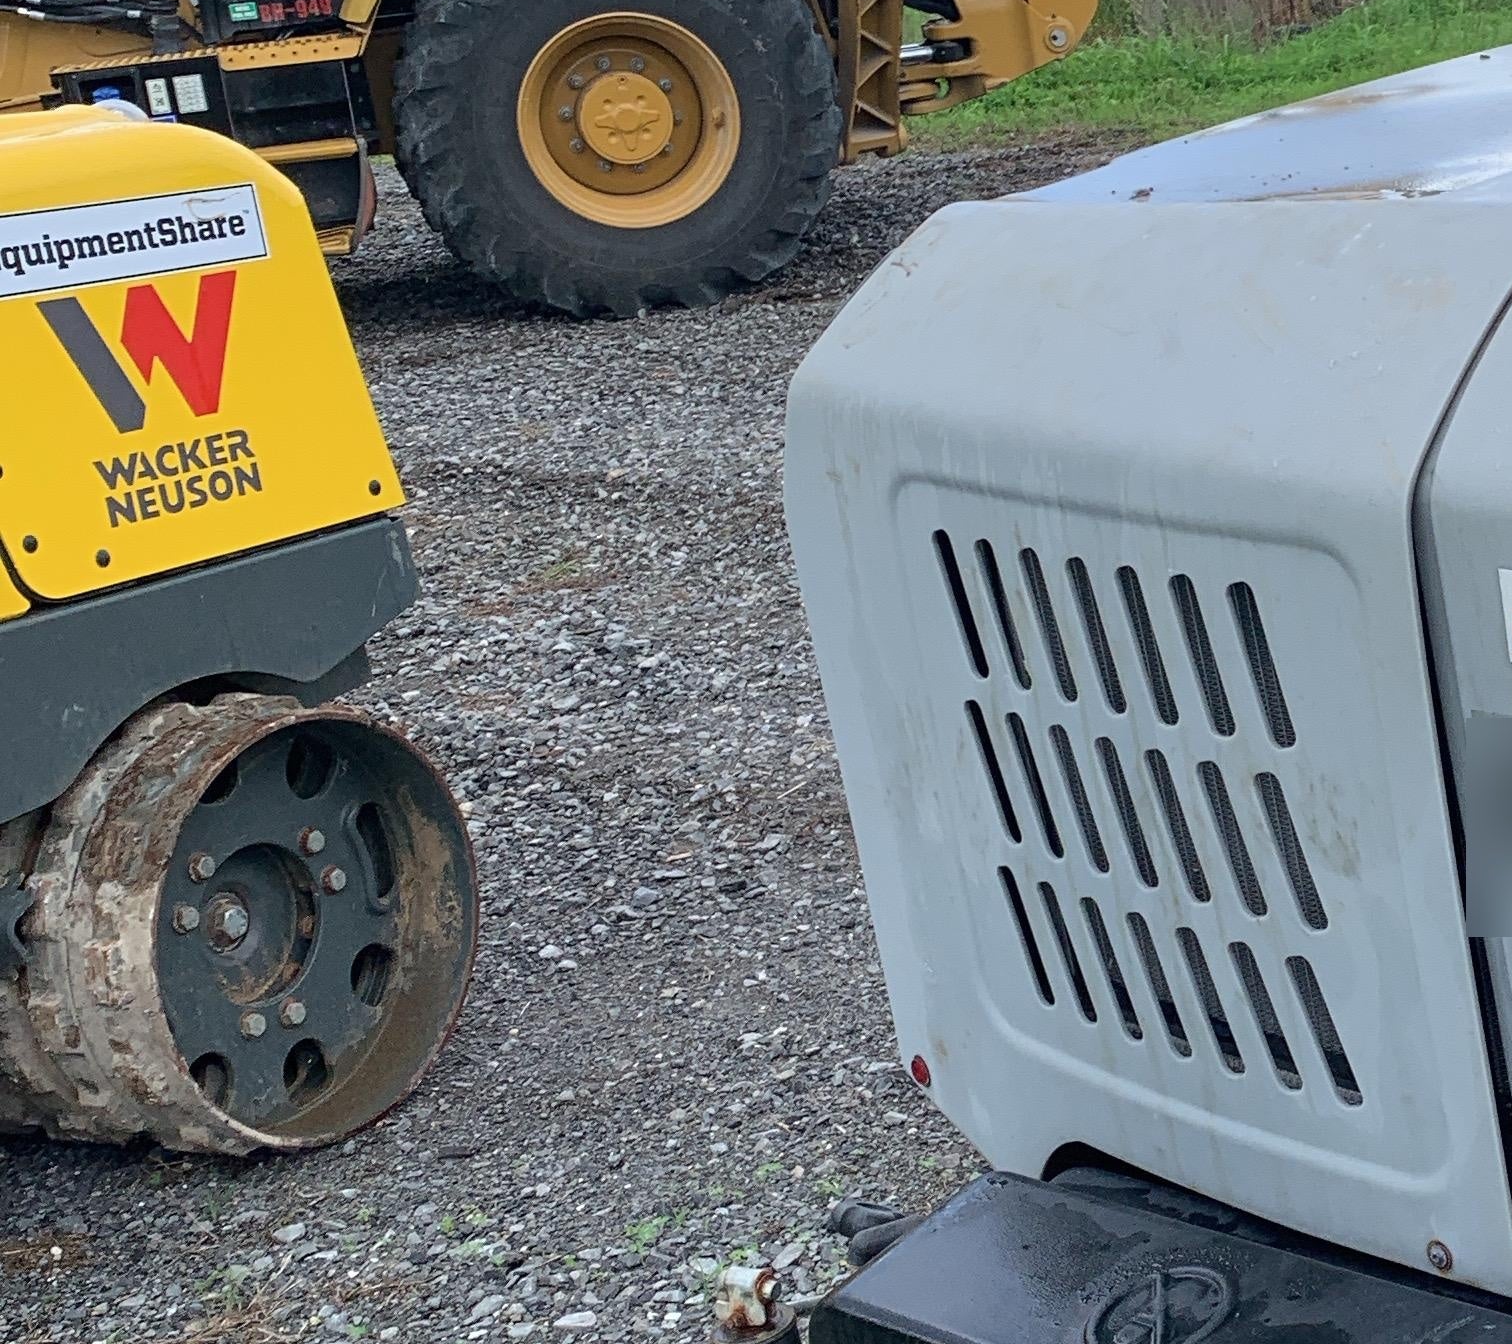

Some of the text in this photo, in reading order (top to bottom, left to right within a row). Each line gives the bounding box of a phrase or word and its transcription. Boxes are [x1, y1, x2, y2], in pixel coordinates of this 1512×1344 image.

[0, 215, 246, 276] quipmentShare
[93, 429, 256, 490] WACKER
[105, 462, 262, 528] NEUSON
